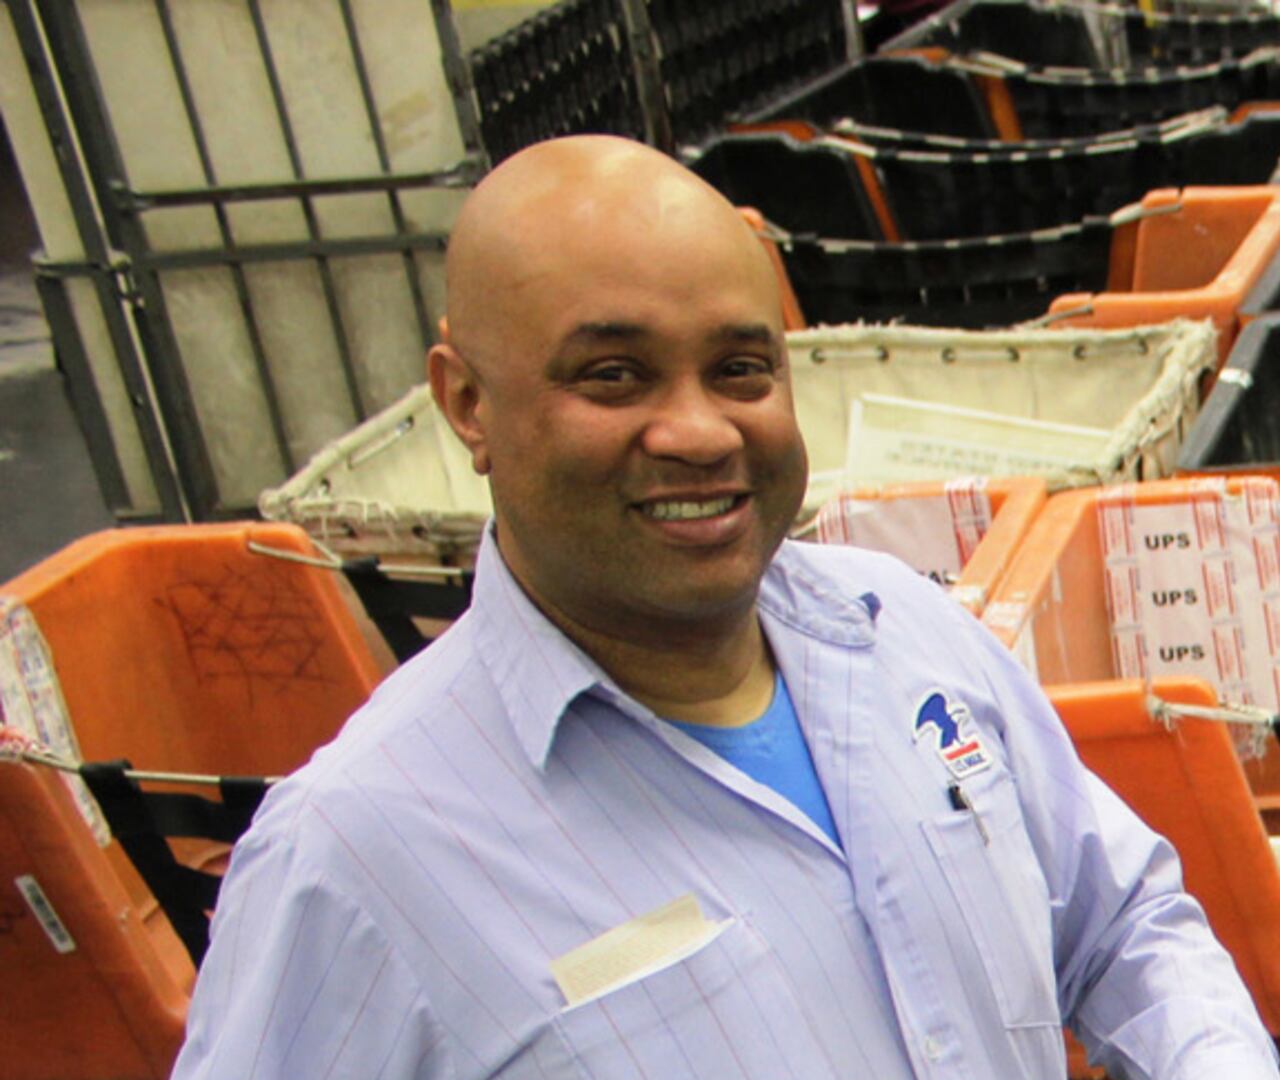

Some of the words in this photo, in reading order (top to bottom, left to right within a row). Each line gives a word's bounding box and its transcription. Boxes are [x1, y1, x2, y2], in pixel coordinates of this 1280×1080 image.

[1145, 533, 1190, 550] UPS
[1152, 588, 1198, 607] UPS
[1160, 644, 1205, 662] UPS
